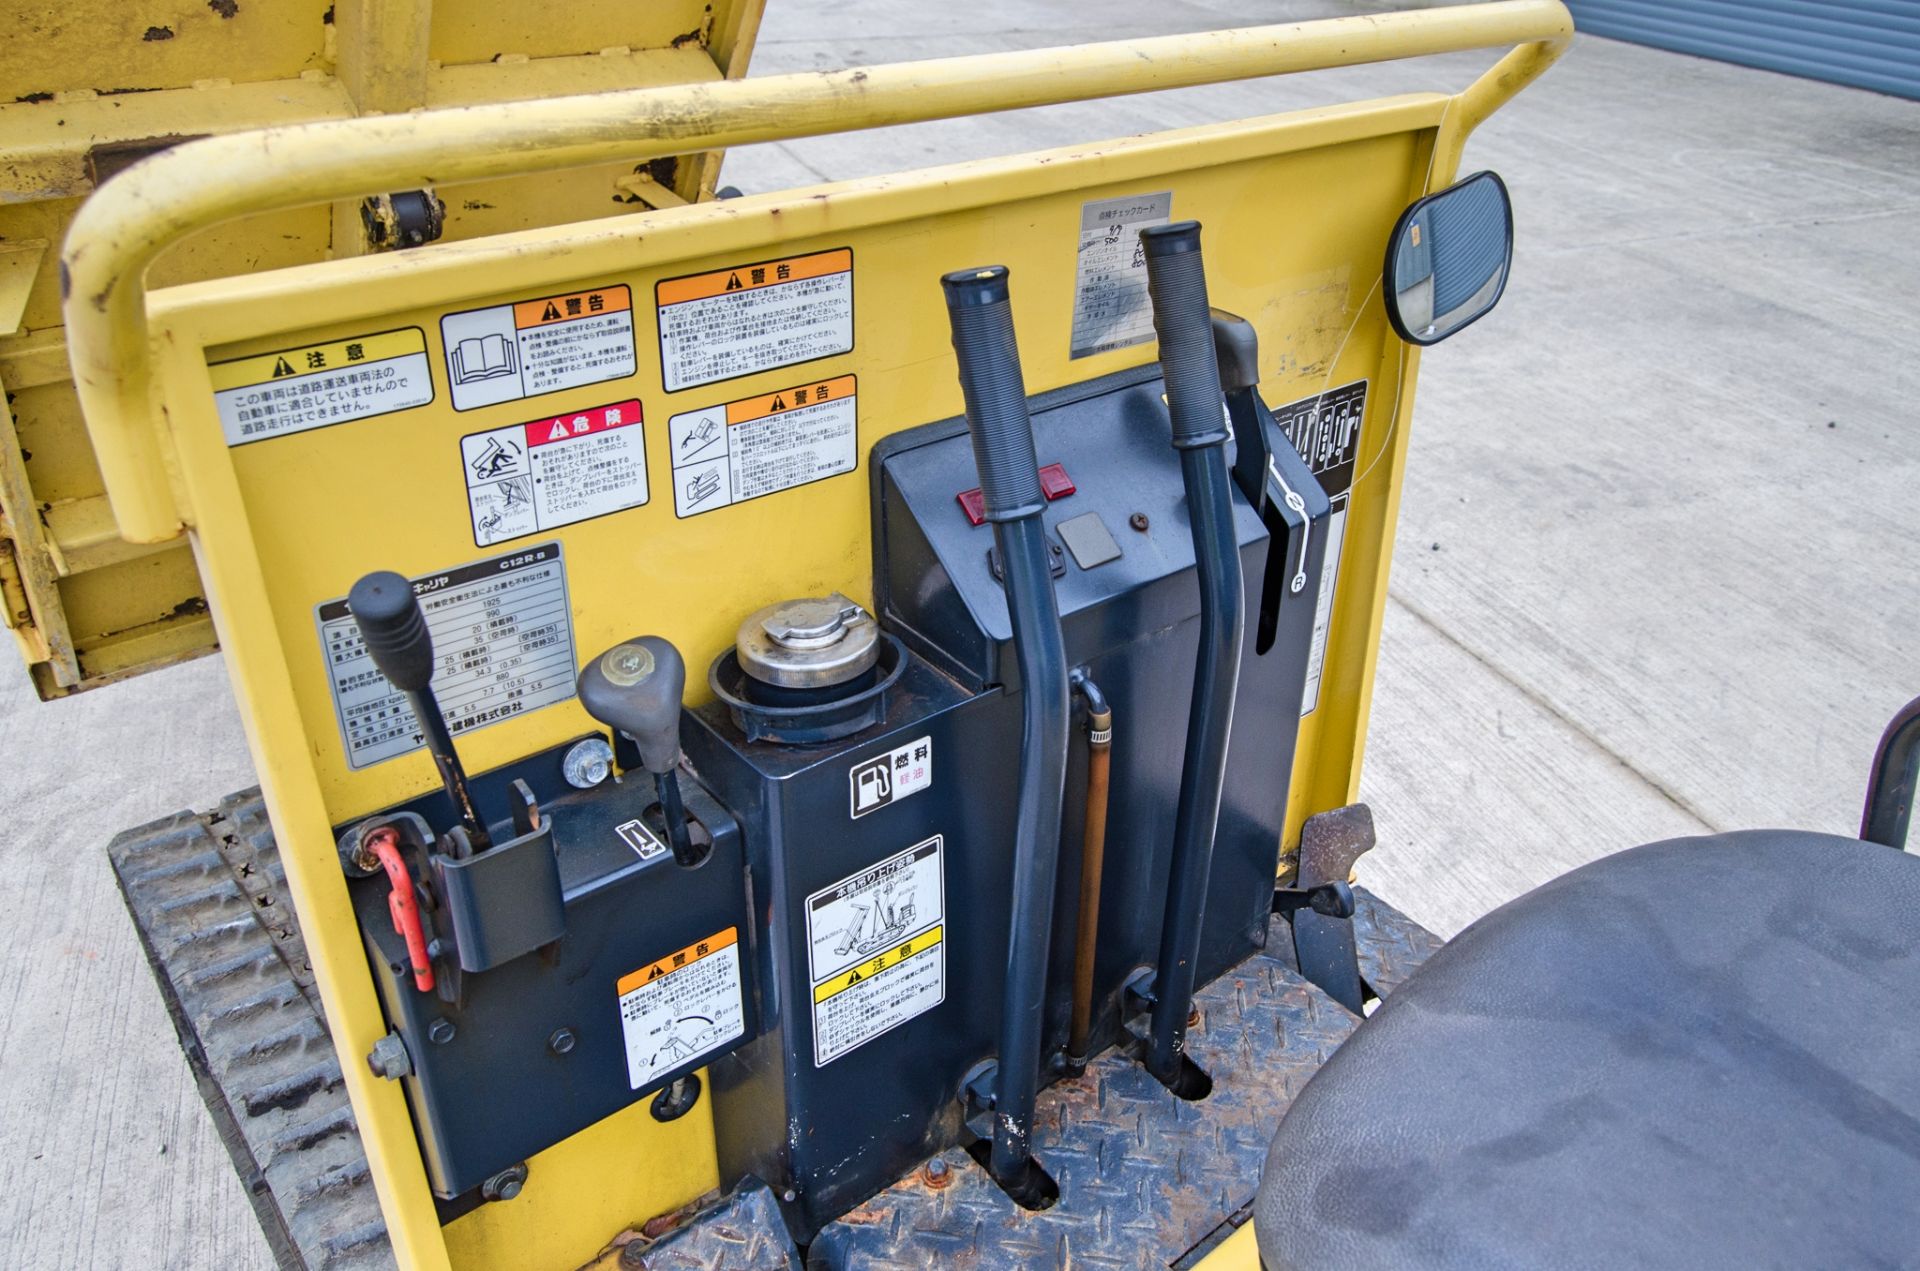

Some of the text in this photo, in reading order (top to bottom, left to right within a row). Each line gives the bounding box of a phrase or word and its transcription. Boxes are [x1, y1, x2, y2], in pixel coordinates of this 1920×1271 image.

[751, 262, 790, 284] 警告
[565, 293, 603, 316] 警告
[305, 342, 365, 369] 注意
[233, 365, 395, 408] この車両は道路運送車両法の
[794, 384, 828, 405] 警告
[236, 377, 409, 422] 自動車に適合していませんので
[239, 398, 370, 436] 道路走行はできません。
[572, 407, 622, 433] 危険
[1294, 575, 1303, 590] R
[482, 596, 500, 608] 1925
[486, 608, 500, 618] 990
[472, 624, 481, 633] 20
[473, 635, 483, 644] 35
[444, 655, 454, 664] 25
[446, 666, 456, 675] 25
[475, 666, 491, 676] 34.3
[496, 671, 509, 681] 880
[464, 703, 476, 713] 5.5
[531, 682, 542, 691] 5.5
[483, 687, 494, 696] 7.7
[895, 742, 929, 770] 燃料
[836, 853, 914, 899] 本機吊り上げ姿勢
[672, 941, 708, 968] 警告
[872, 942, 912, 972] 注意
